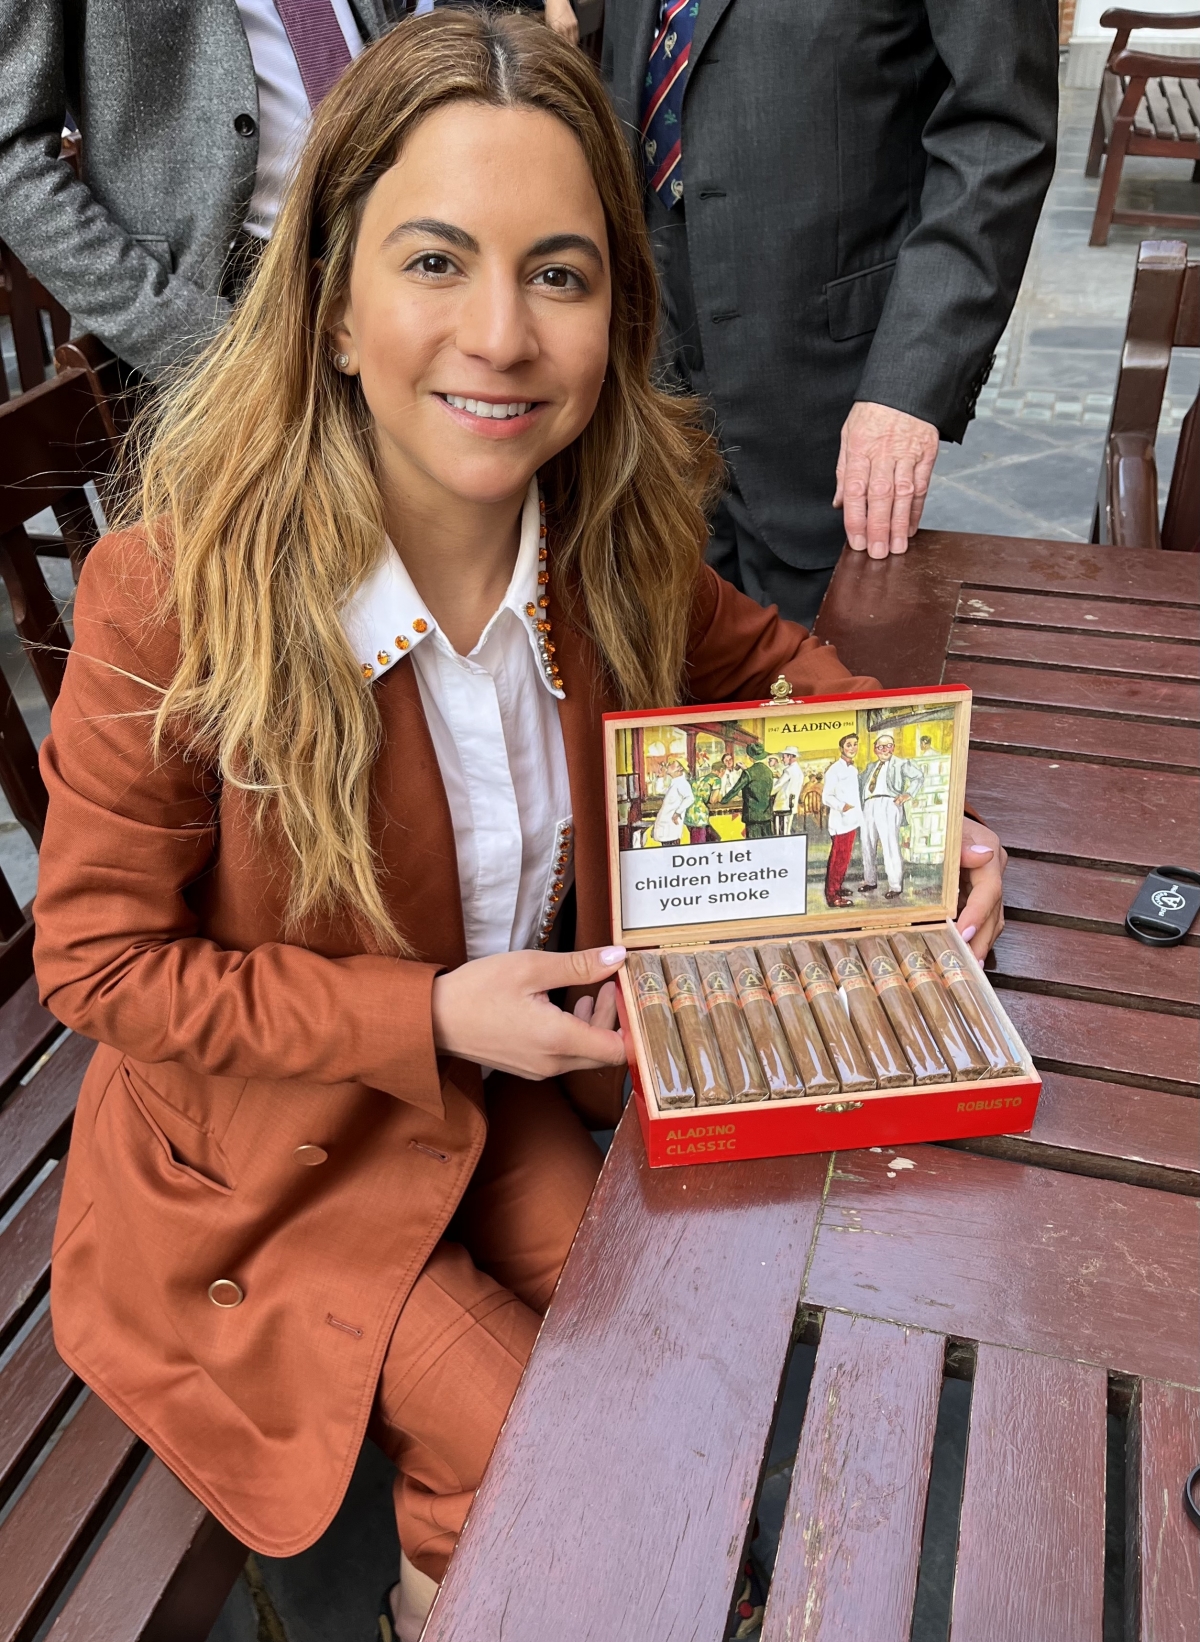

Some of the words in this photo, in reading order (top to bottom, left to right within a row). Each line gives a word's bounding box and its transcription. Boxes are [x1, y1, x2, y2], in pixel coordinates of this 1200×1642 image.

[729, 849, 752, 863] let
[635, 875, 711, 891] children
[718, 867, 788, 884] breathe
[660, 895, 702, 911] your
[708, 888, 770, 904] smoke
[1161, 897, 1180, 908] A
[778, 968, 796, 982] A
[811, 966, 829, 979] A
[843, 962, 861, 976] A
[877, 961, 895, 976] A
[745, 973, 762, 987] A
[956, 1096, 1023, 1113] ROBUSTO
[665, 1124, 736, 1141] ALADINO
[666, 1139, 737, 1155] CLASSIC
